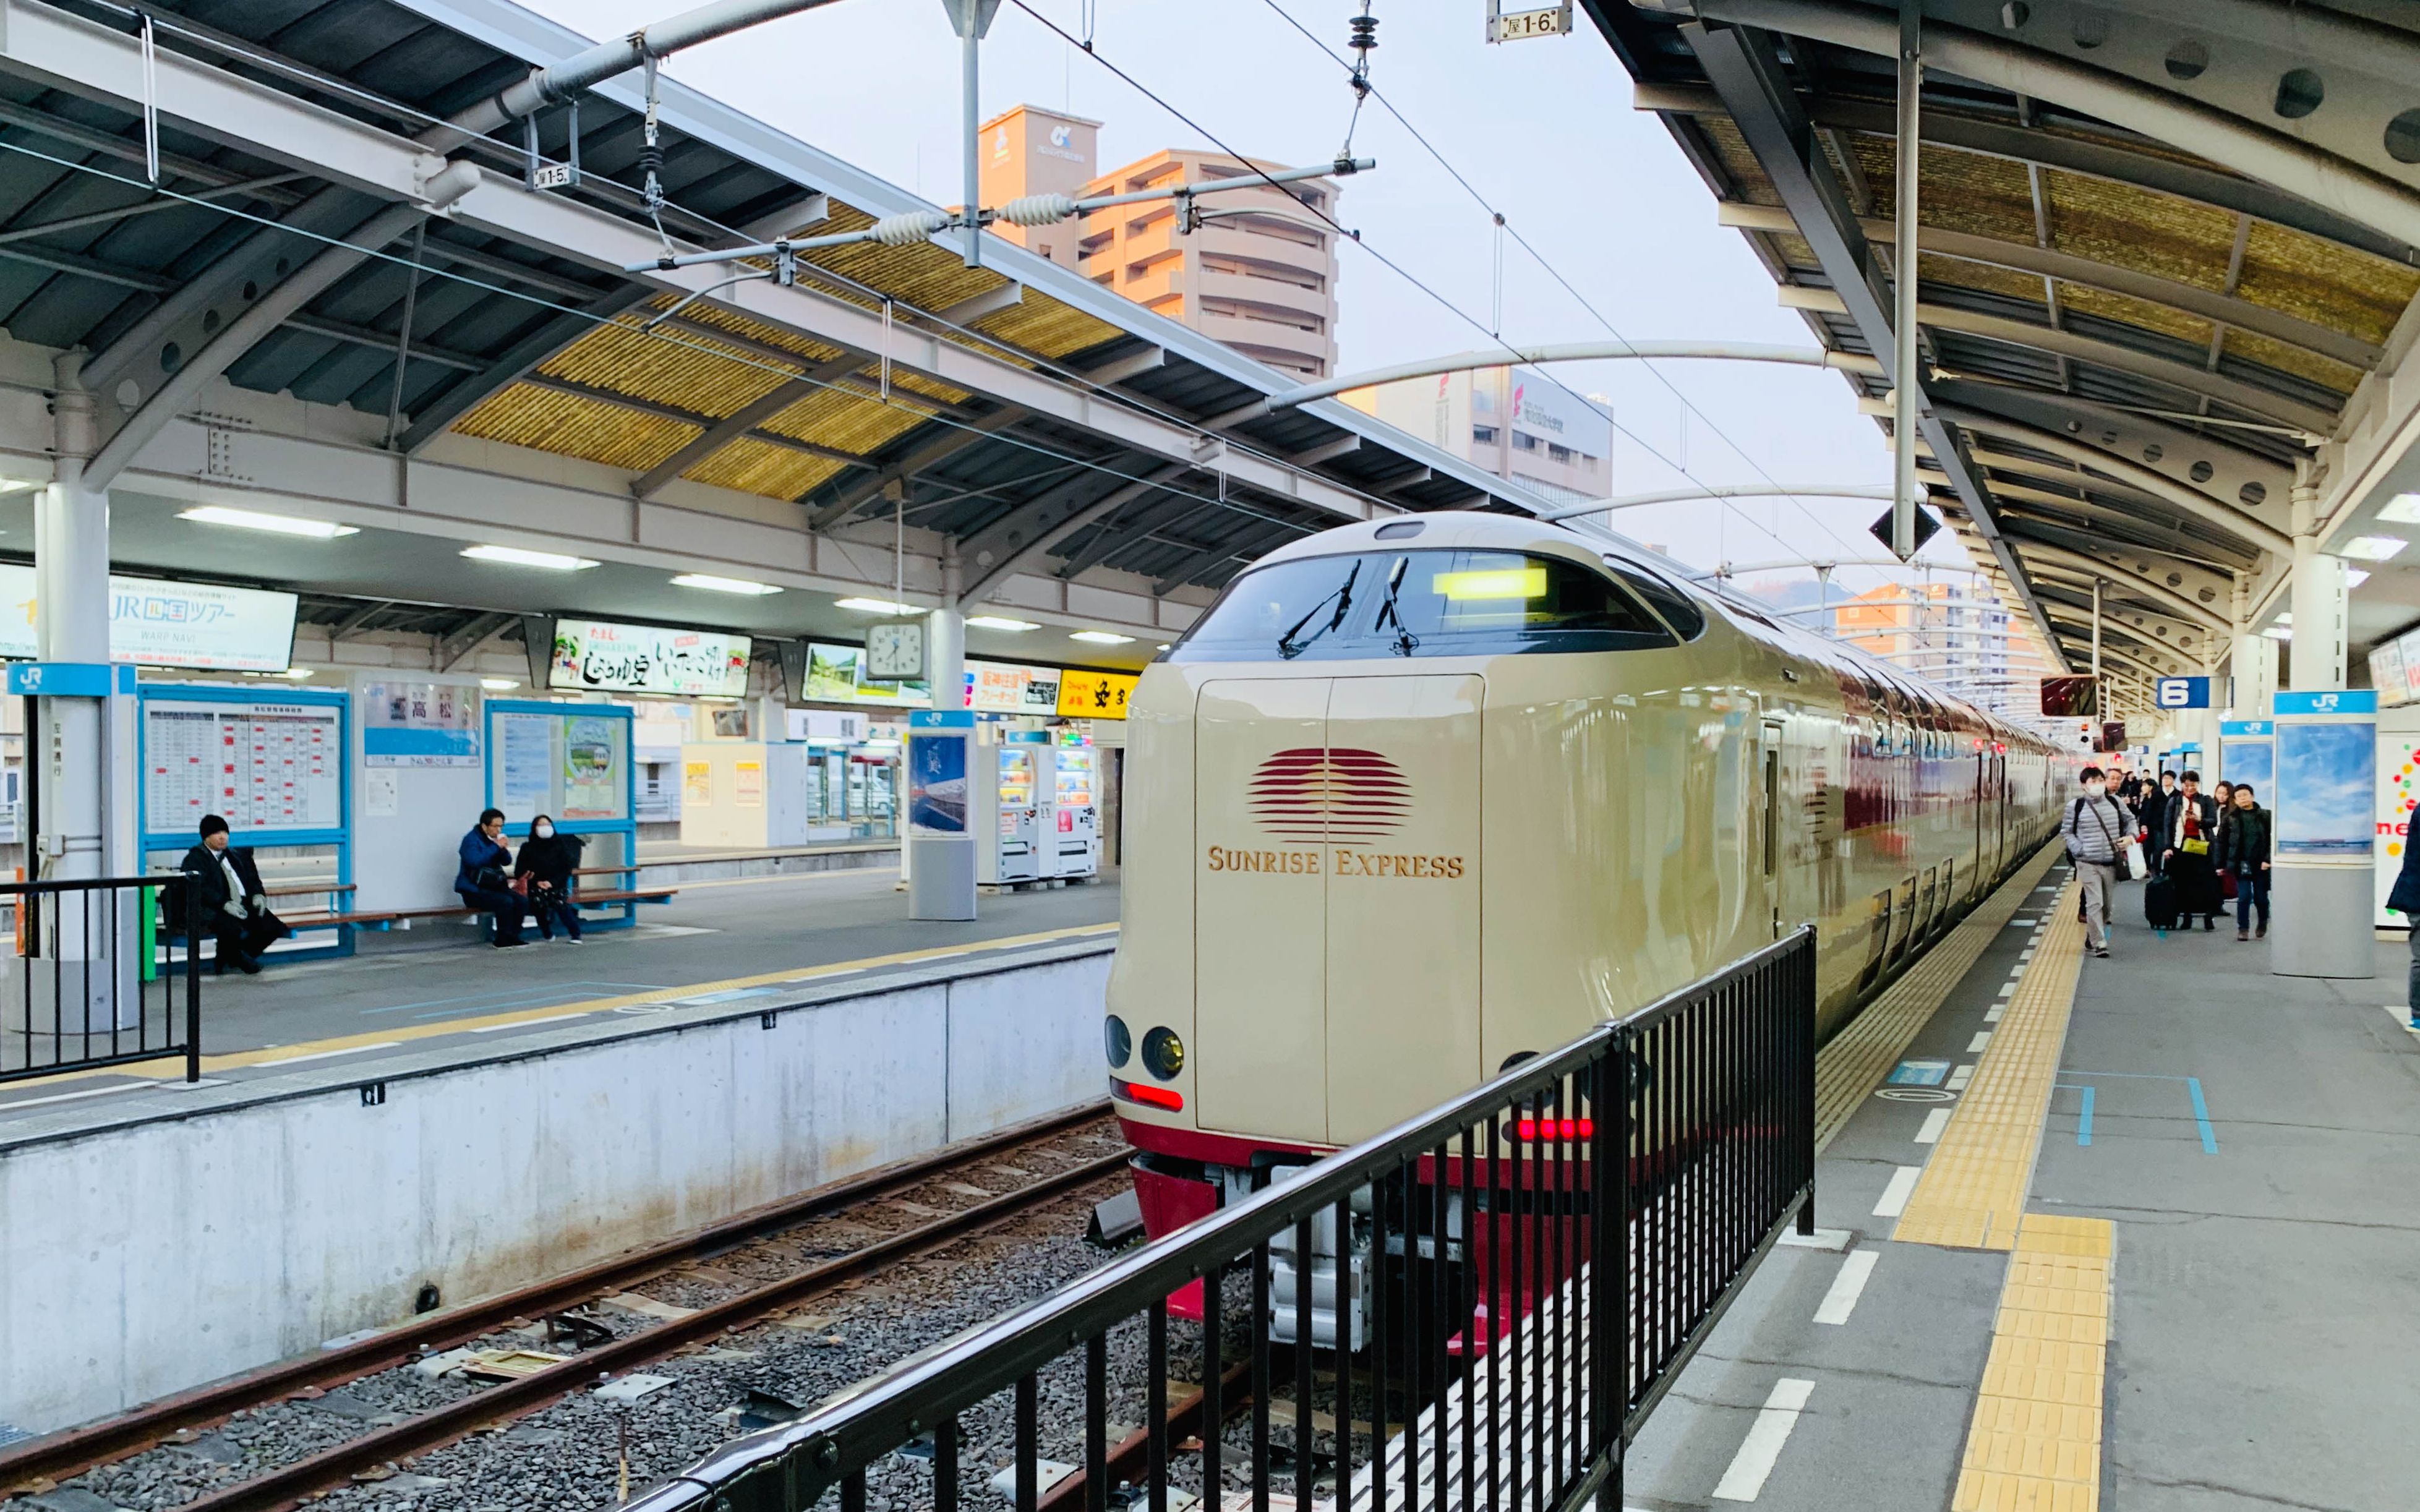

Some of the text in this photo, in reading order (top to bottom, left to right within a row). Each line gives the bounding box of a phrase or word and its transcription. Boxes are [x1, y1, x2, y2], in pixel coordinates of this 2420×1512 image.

[141, 630, 197, 644] WARP NAVI
[20, 667, 42, 685] JR
[2161, 680, 2189, 706] 6
[2311, 694, 2340, 707] JR
[925, 712, 943, 723] JR
[2244, 722, 2262, 732] JR
[1208, 845, 1466, 879] SUNRISE EXPRESS
